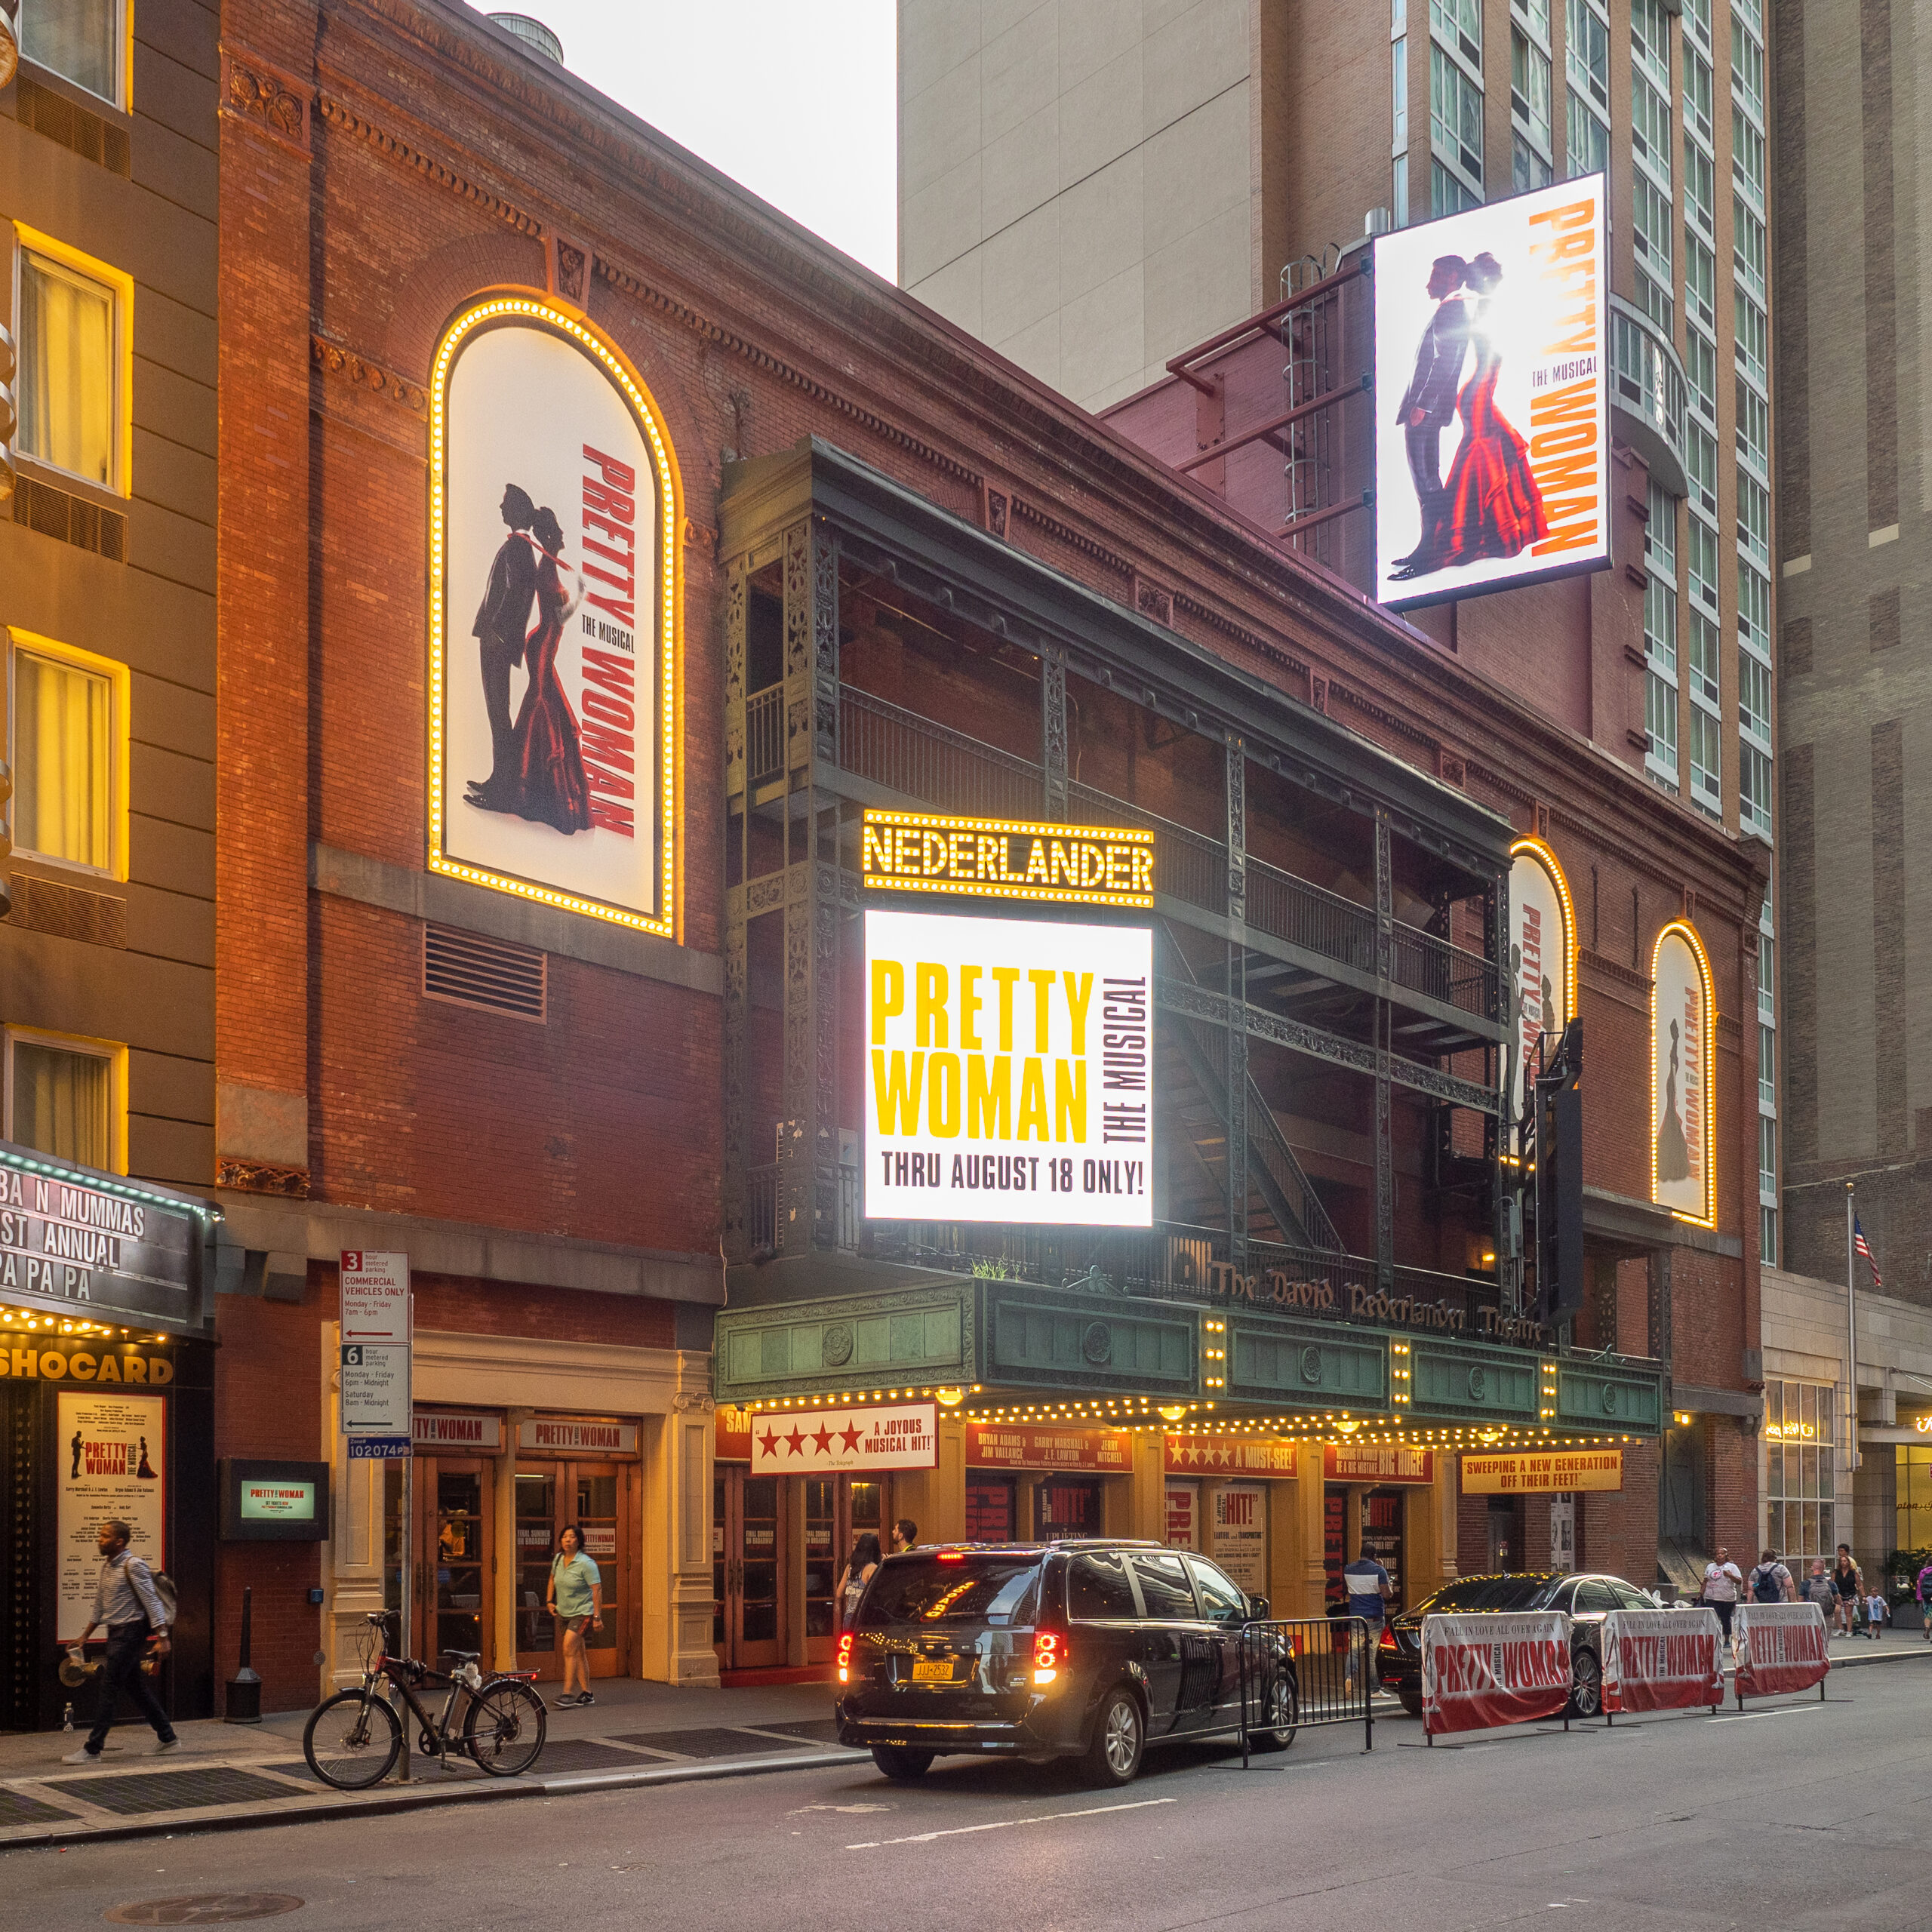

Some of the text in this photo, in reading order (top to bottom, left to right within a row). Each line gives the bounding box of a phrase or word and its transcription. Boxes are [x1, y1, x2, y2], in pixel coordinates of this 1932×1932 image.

[1532, 355, 1597, 387] THE MUSICAL
[1531, 378, 1598, 557] WOMAN
[583, 443, 635, 629] PRETTY
[582, 614, 635, 654] THE MUSICAL
[582, 645, 635, 839] WOMAN
[863, 826, 1154, 891] NEDERLANDER
[1523, 903, 1540, 1004] PRETTY
[871, 958, 1094, 1056] PRETTY
[1685, 986, 1698, 1075] PRETTY
[1103, 977, 1146, 1143] THE MUSICAL
[871, 1049, 1087, 1143] WOMAN
[881, 1151, 1143, 1195] THRU AUGUST 18 ONLY!
[36, 1180, 50, 1213] N
[60, 1187, 145, 1237] MUMMAS
[1, 1211, 119, 1268] ST ANNUAL
[347, 1253, 358, 1270] 3
[27, 1258, 91, 1300] PA PA
[345, 1277, 396, 1286] COMMERCIAL
[345, 1287, 405, 1296] VEHICLES ONLY
[1208, 1260, 1258, 1300] The
[1266, 1269, 1334, 1309] David
[1344, 1282, 1467, 1330] Nederlander
[374, 1300, 392, 1309] Friday
[346, 1346, 358, 1364] 6
[437, 1419, 482, 1441] WOMAN
[536, 1423, 620, 1447] PRETTY WOMAN
[874, 1419, 921, 1435] A JOYOUS
[865, 1438, 906, 1454] MUSICAL
[978, 1433, 1026, 1447] BRYAN ADAMS &
[1034, 1437, 1088, 1450] GARRY MARSHALL &
[1101, 1439, 1118, 1451] JERRY
[85, 1442, 127, 1458] PRETTY
[128, 1443, 137, 1466] MUSICAL
[350, 1445, 396, 1457] 102074
[981, 1446, 1023, 1460] JIM VALLANCE
[1044, 1449, 1079, 1462] J. F. LAWTON
[1097, 1451, 1122, 1463] MITCHELL
[1235, 1445, 1241, 1468] A
[1357, 1447, 1361, 1460] IT
[1362, 1448, 1377, 1461] WOULD
[85, 1459, 126, 1475] WOMAN
[128, 1466, 137, 1475] THE
[1336, 1460, 1378, 1474] BE A BIG MISTAKE.
[1380, 1449, 1397, 1475] BIG.
[1520, 1460, 1526, 1472] A
[1530, 1459, 1551, 1472] NEW
[1555, 1456, 1617, 1471] GENERATION
[1500, 1475, 1517, 1487] OFF
[1521, 1473, 1549, 1487] THEIR
[251, 1489, 274, 1497] PRETTY
[278, 1490, 304, 1498] WOMAN
[1444, 1623, 1555, 1637] FALL IN LOVE ALL OVER AGAIN
[1646, 1620, 1661, 1629] LOVE
[1663, 1620, 1671, 1629] ALL
[1672, 1620, 1687, 1629] OVER
[1688, 1620, 1706, 1628] AGAIN
[1666, 1635, 1714, 1676] WOMAN
[1435, 1640, 1571, 1694] PRETTY WOMAN
